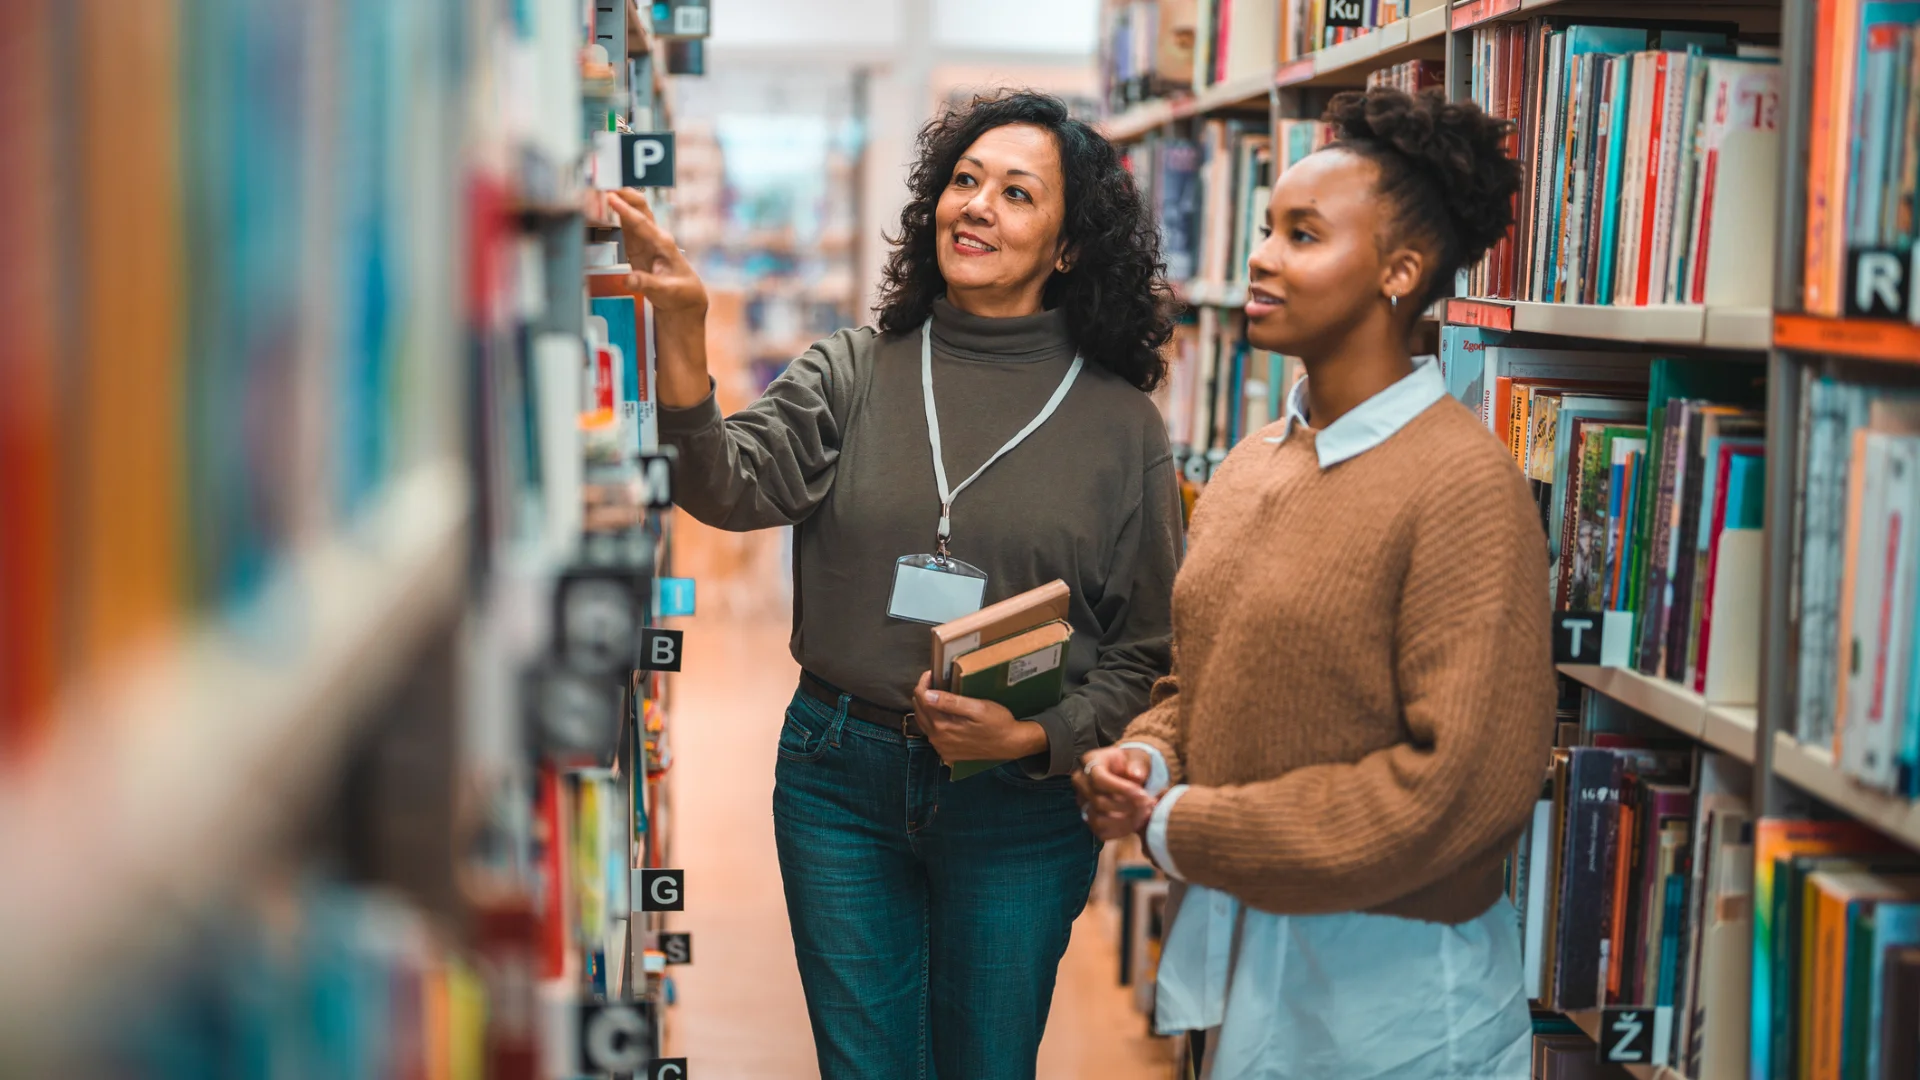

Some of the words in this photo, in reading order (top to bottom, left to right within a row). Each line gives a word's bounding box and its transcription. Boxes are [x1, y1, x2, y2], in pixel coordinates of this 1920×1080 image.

[1329, 0, 1360, 20] Ku
[633, 139, 665, 179] P
[1854, 251, 1903, 314] R
[1482, 389, 1491, 427] ovrinka
[651, 636, 675, 664] B
[1561, 618, 1593, 658] T
[651, 876, 678, 905] G
[1608, 1012, 1644, 1062] Ž
